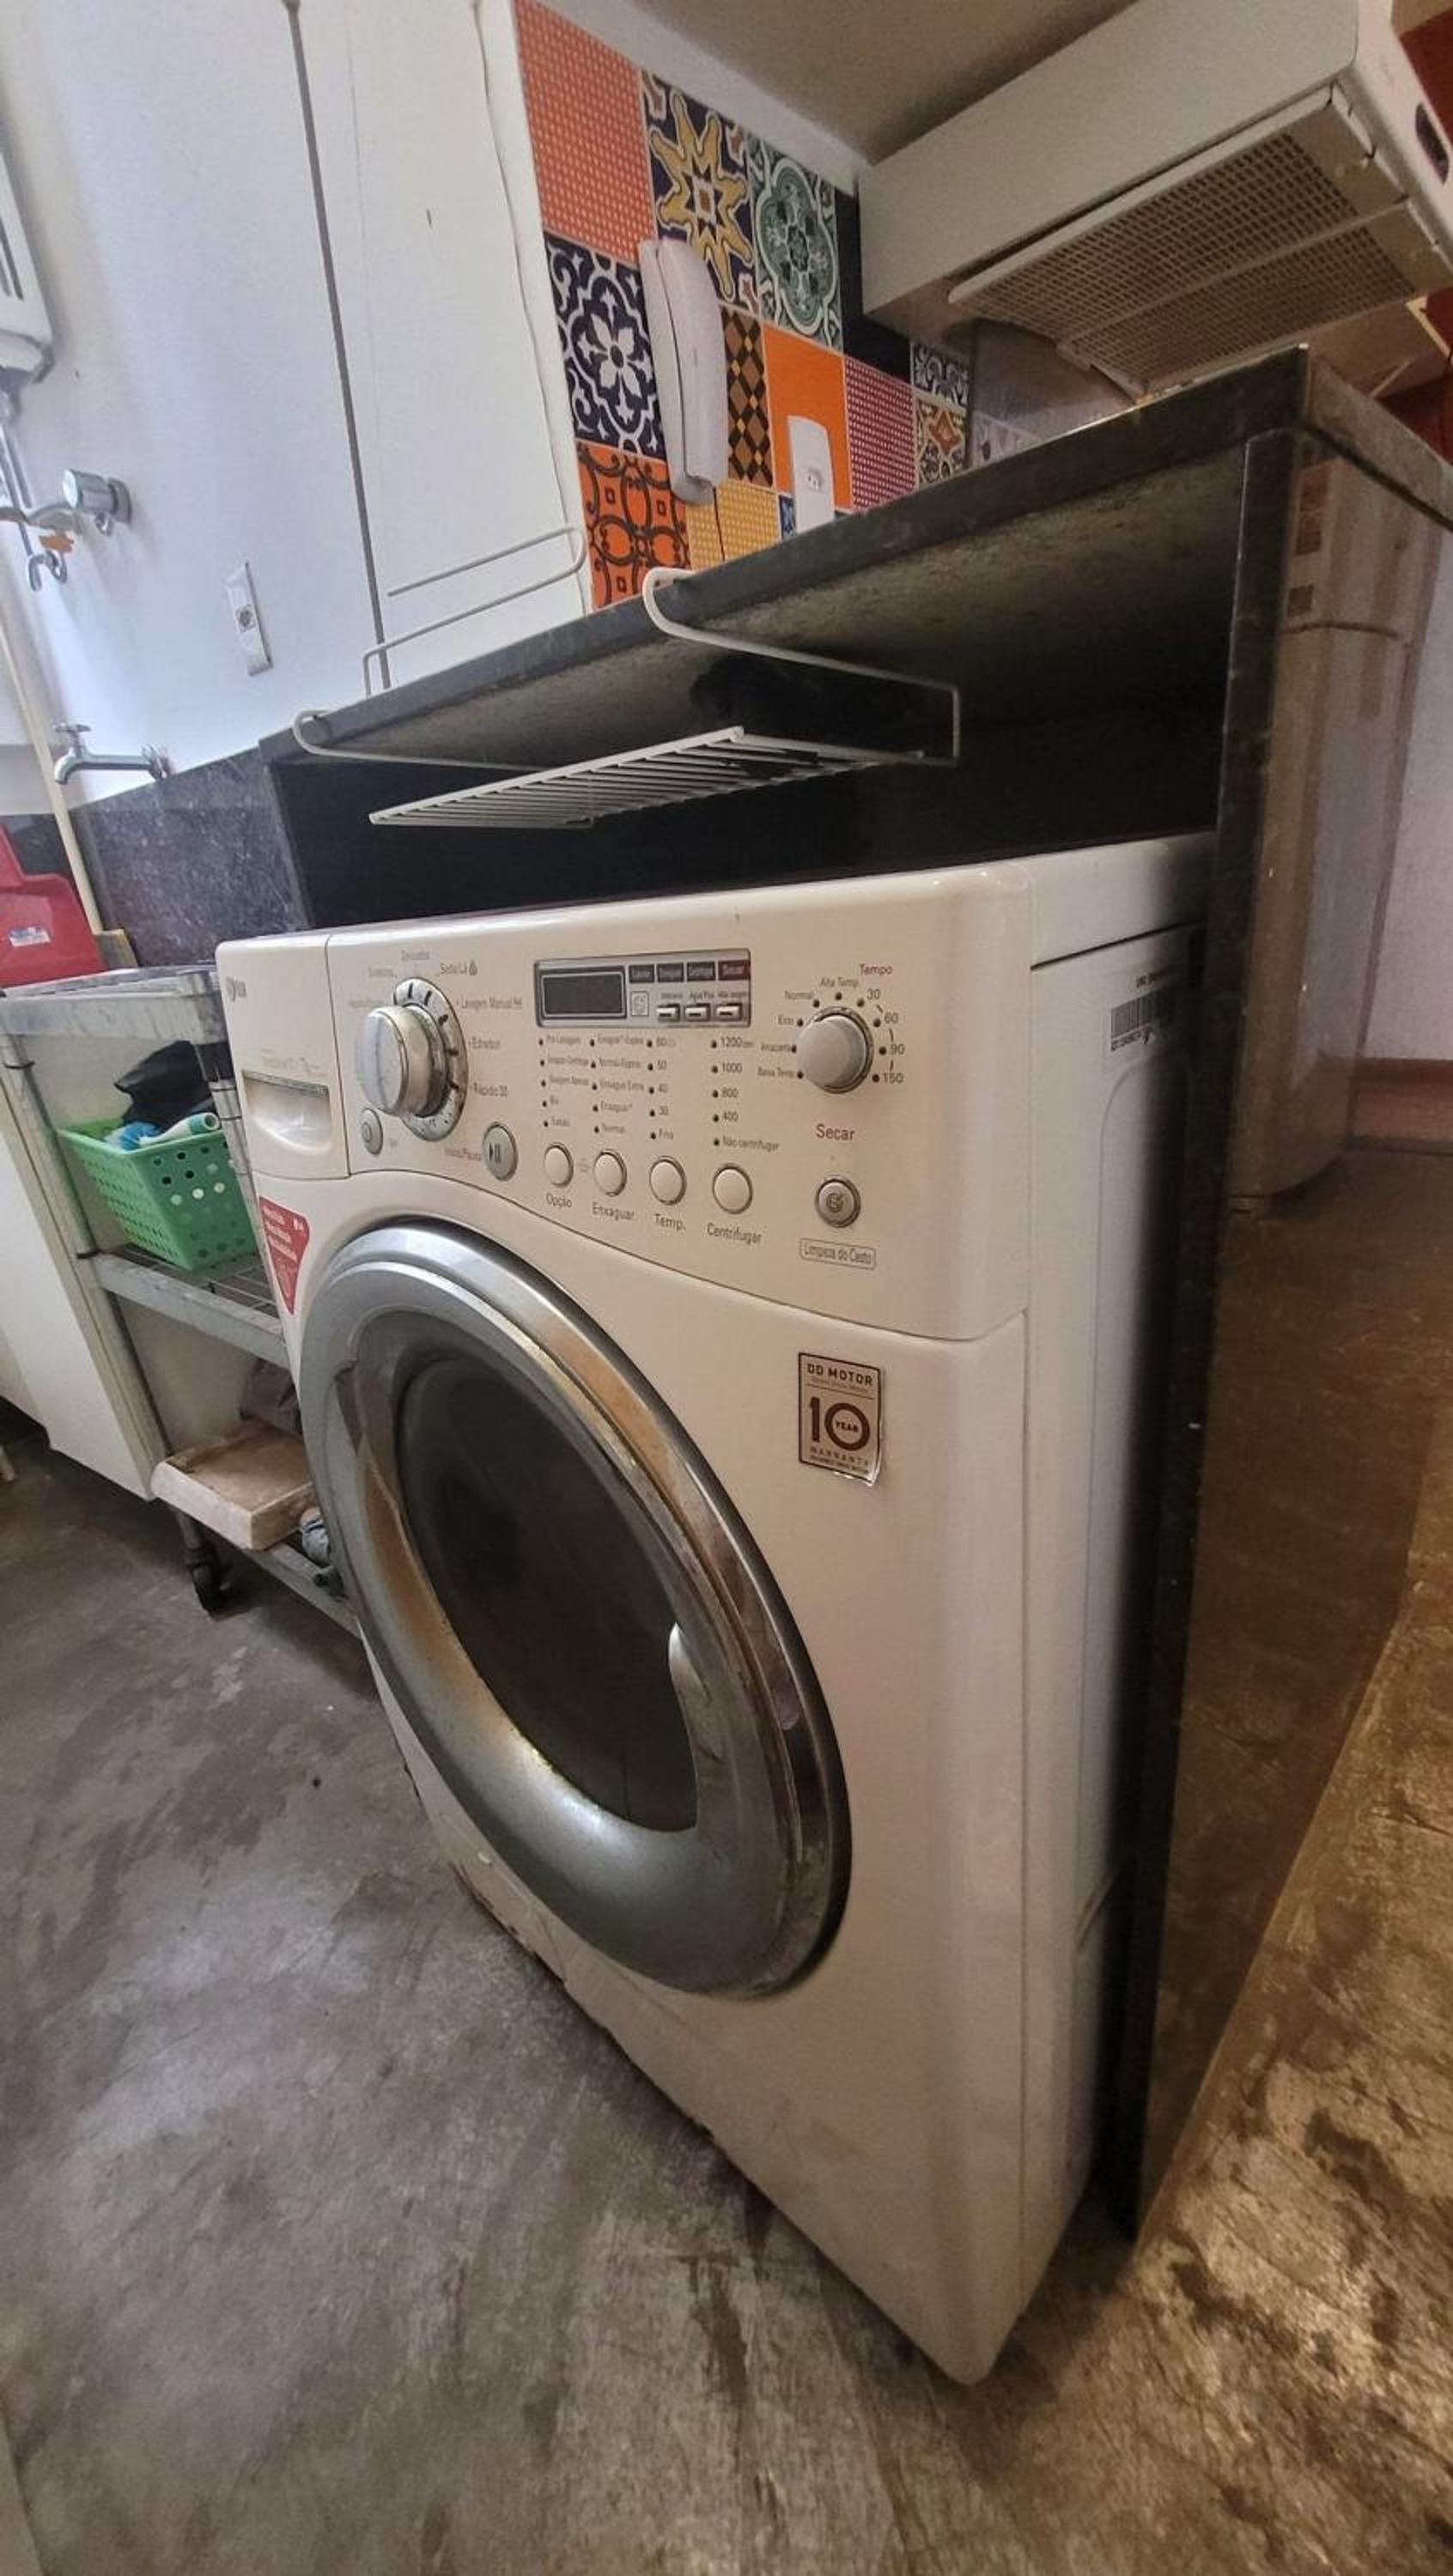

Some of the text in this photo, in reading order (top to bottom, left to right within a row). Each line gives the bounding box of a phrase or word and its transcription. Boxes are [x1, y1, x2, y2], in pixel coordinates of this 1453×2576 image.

[860, 963, 893, 975] Tempo
[866, 988, 881, 1000] 30
[884, 1012, 899, 1024] 60
[891, 1043, 905, 1055] 90
[721, 1062, 743, 1073] 1000
[884, 1072, 903, 1084] 150
[721, 1087, 739, 1098] 800
[723, 1111, 739, 1122] 400
[816, 1123, 855, 1140] Secar
[546, 1192, 573, 1208] Opção
[707, 1222, 762, 1245] Centrifugar
[828, 1368, 873, 1386] MOTOR
[809, 1397, 871, 1451] 10
[836, 1421, 860, 1432] YEAR
